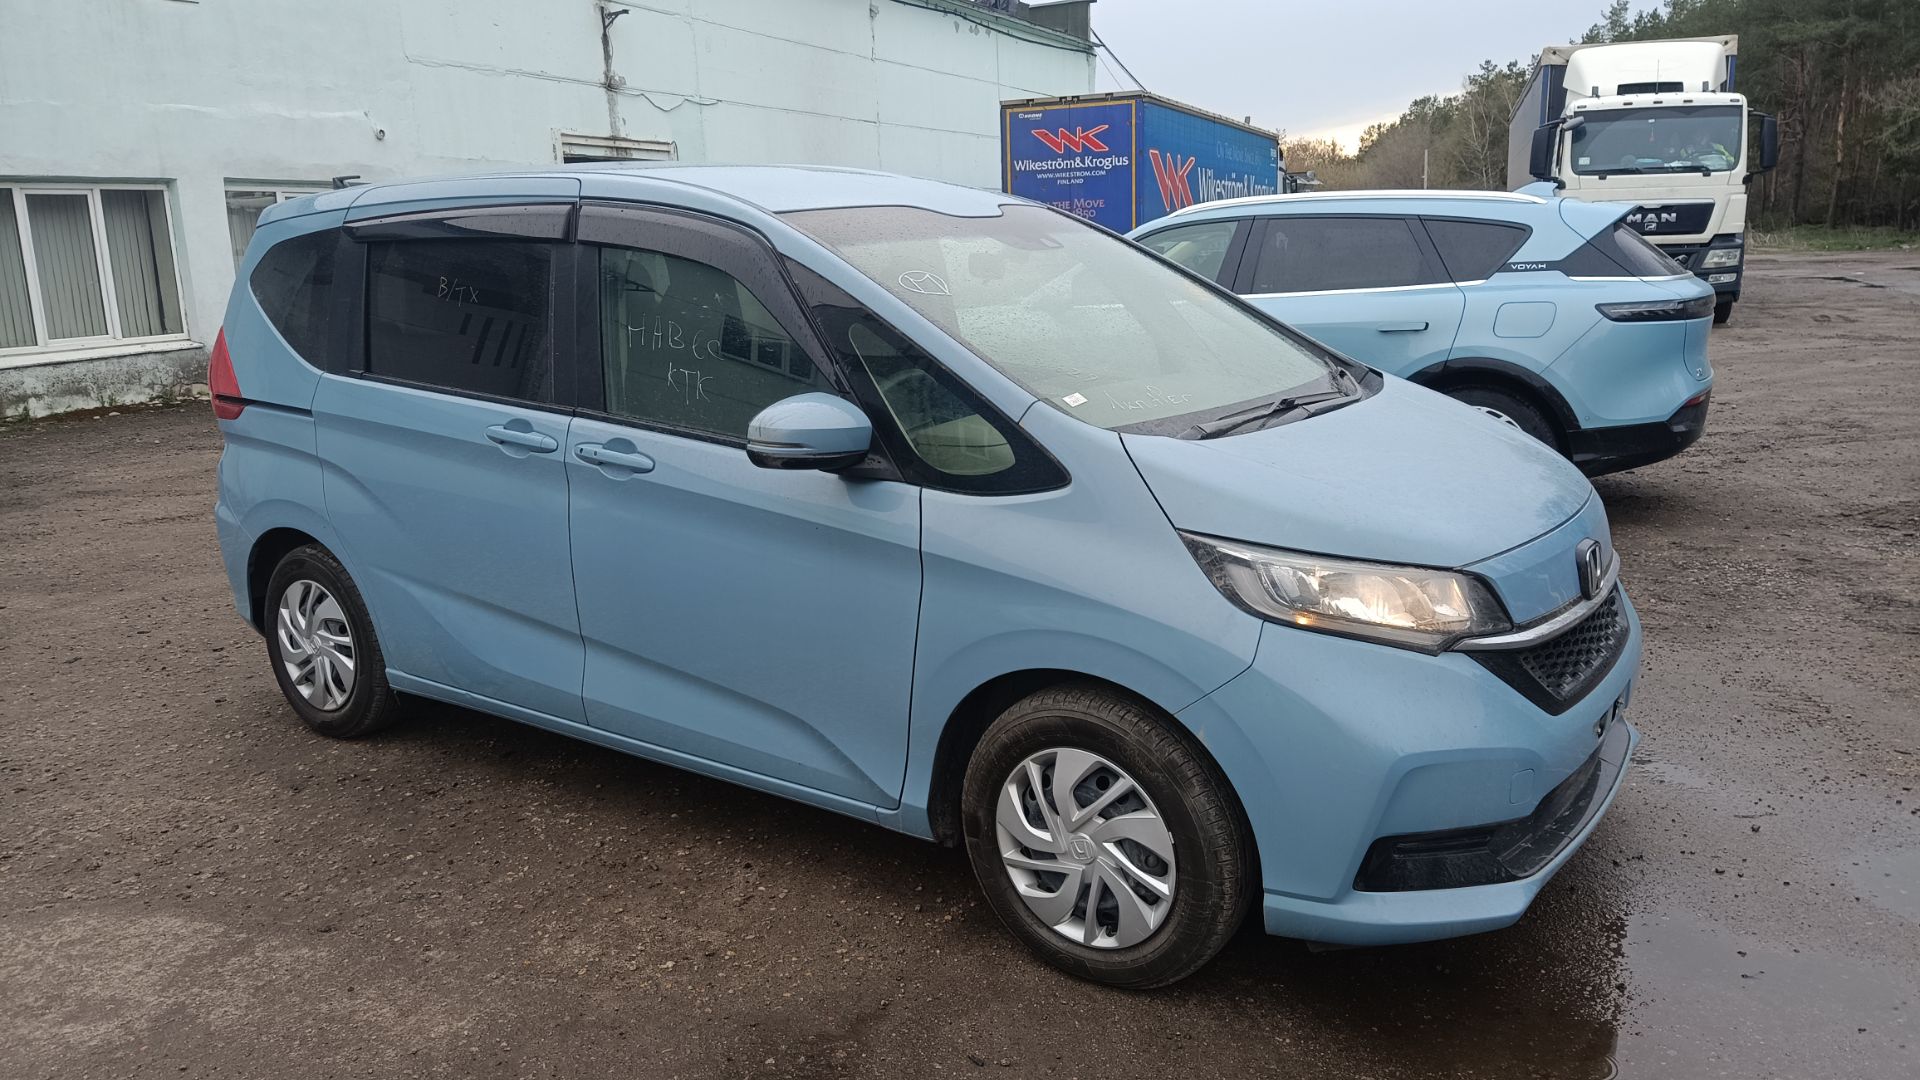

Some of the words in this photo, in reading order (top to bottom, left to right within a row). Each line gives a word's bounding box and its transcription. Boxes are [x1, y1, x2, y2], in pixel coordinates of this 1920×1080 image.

[1031, 124, 1109, 154] WK
[1149, 149, 1196, 212] WK
[1626, 212, 1677, 223] MAN
